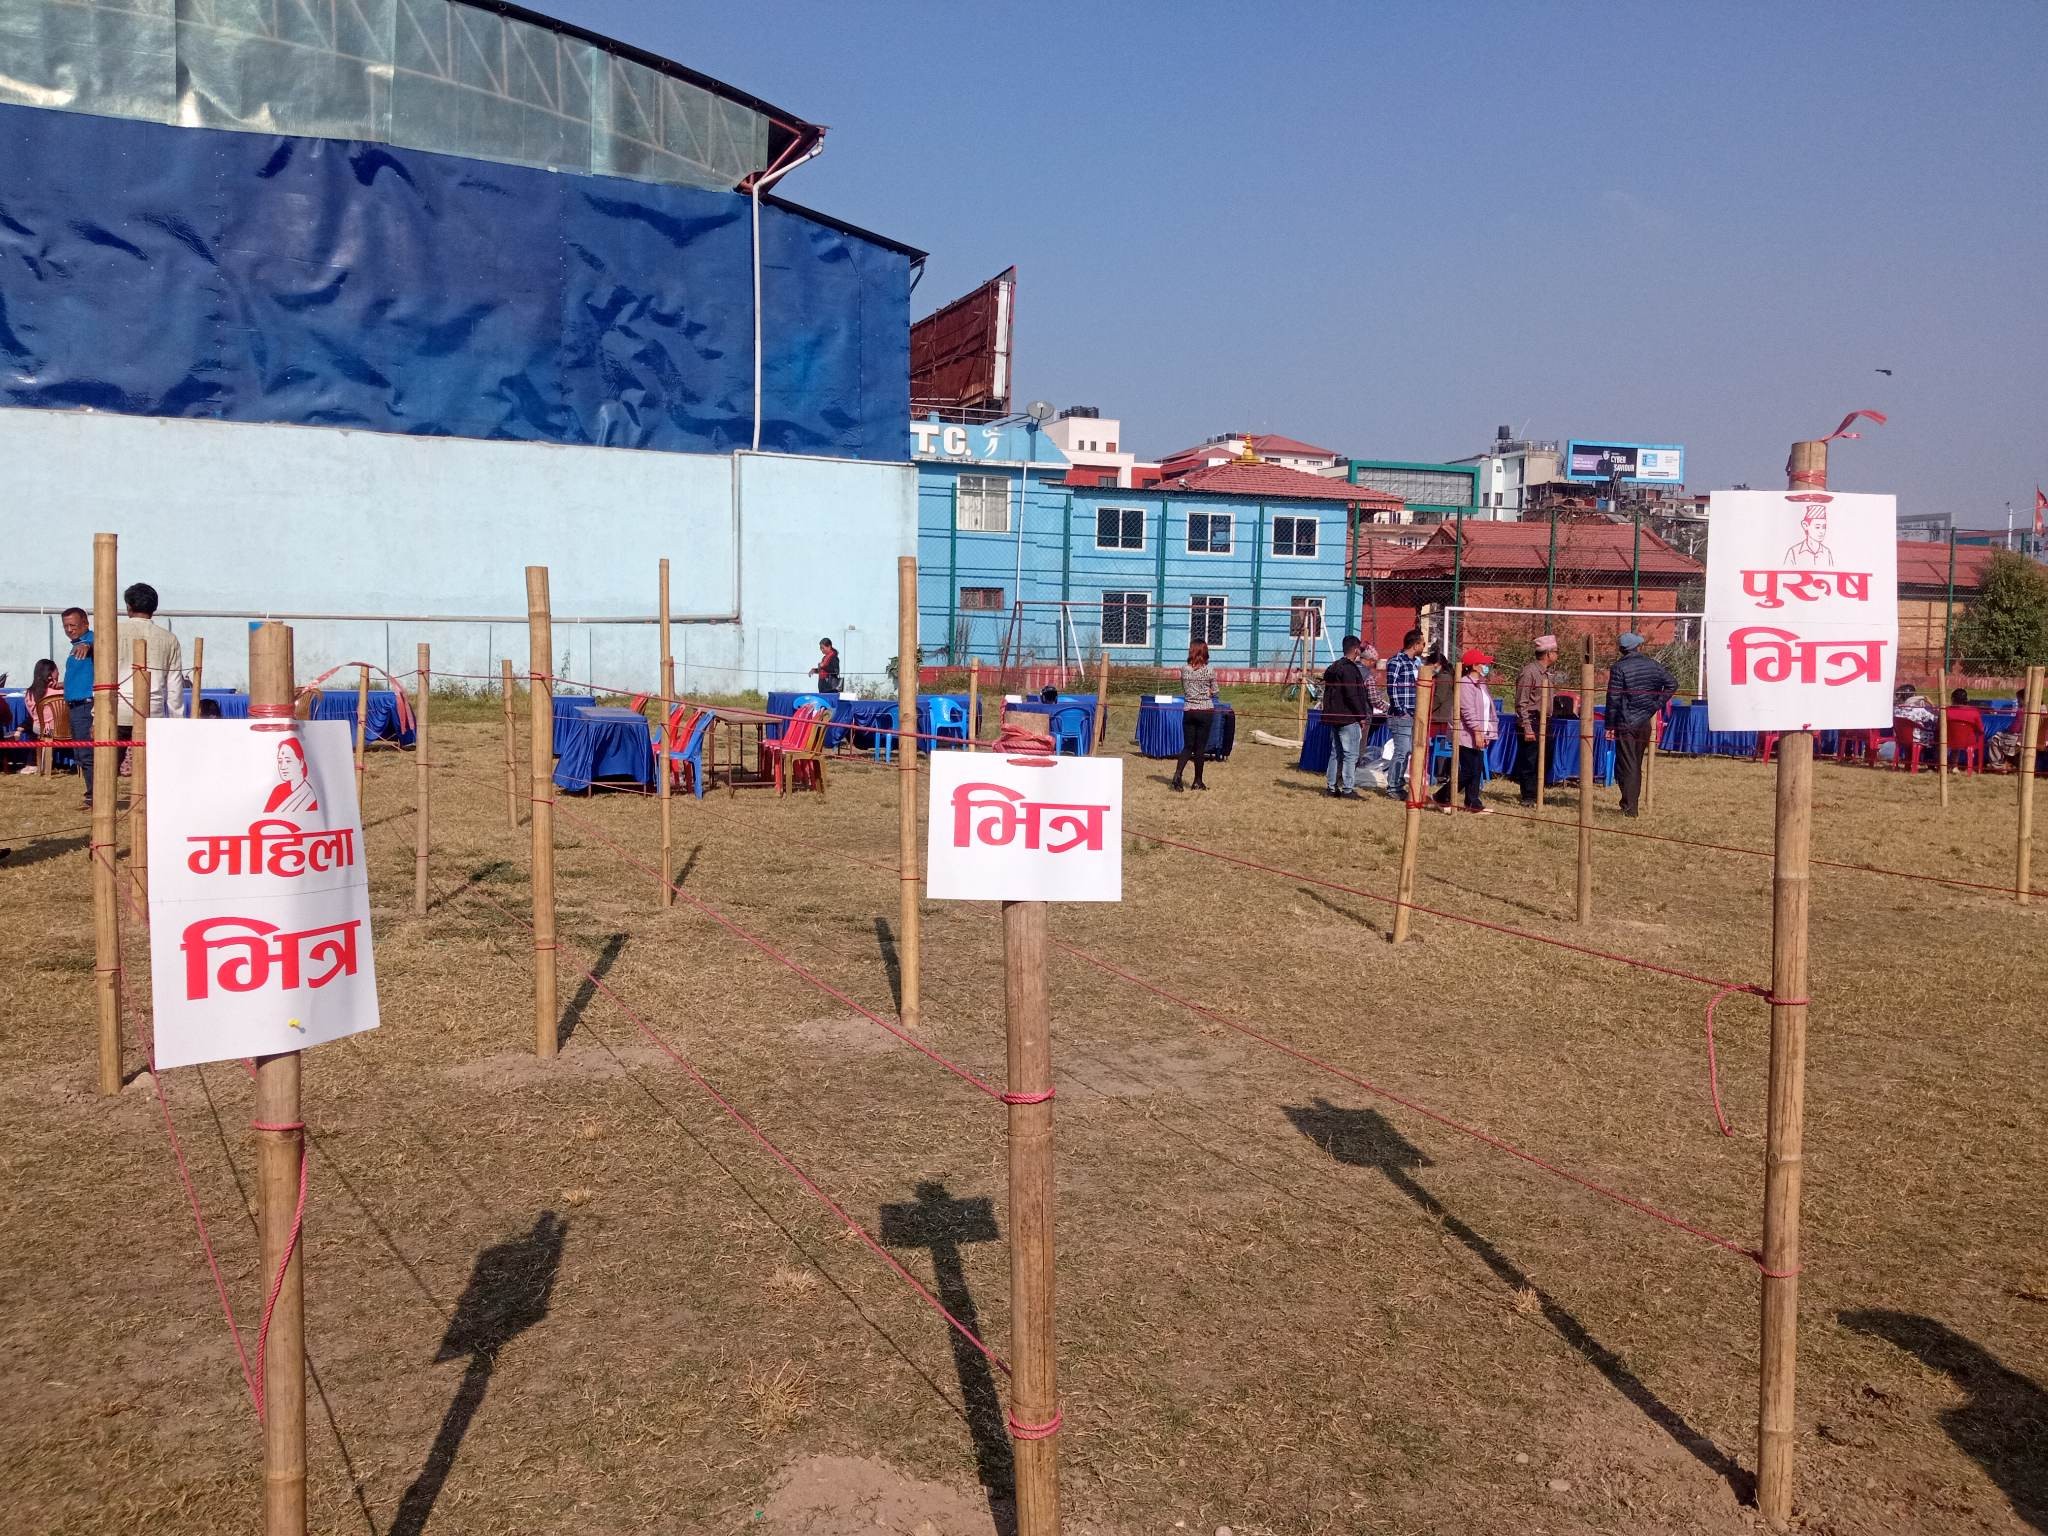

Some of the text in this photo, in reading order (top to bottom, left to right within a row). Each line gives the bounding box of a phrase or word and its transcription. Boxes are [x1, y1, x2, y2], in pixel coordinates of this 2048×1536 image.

[1728, 626, 1888, 686] भित्र
[187, 819, 354, 878] महिला
[951, 782, 1110, 853] भित्र
[180, 917, 361, 1000] भित्र
